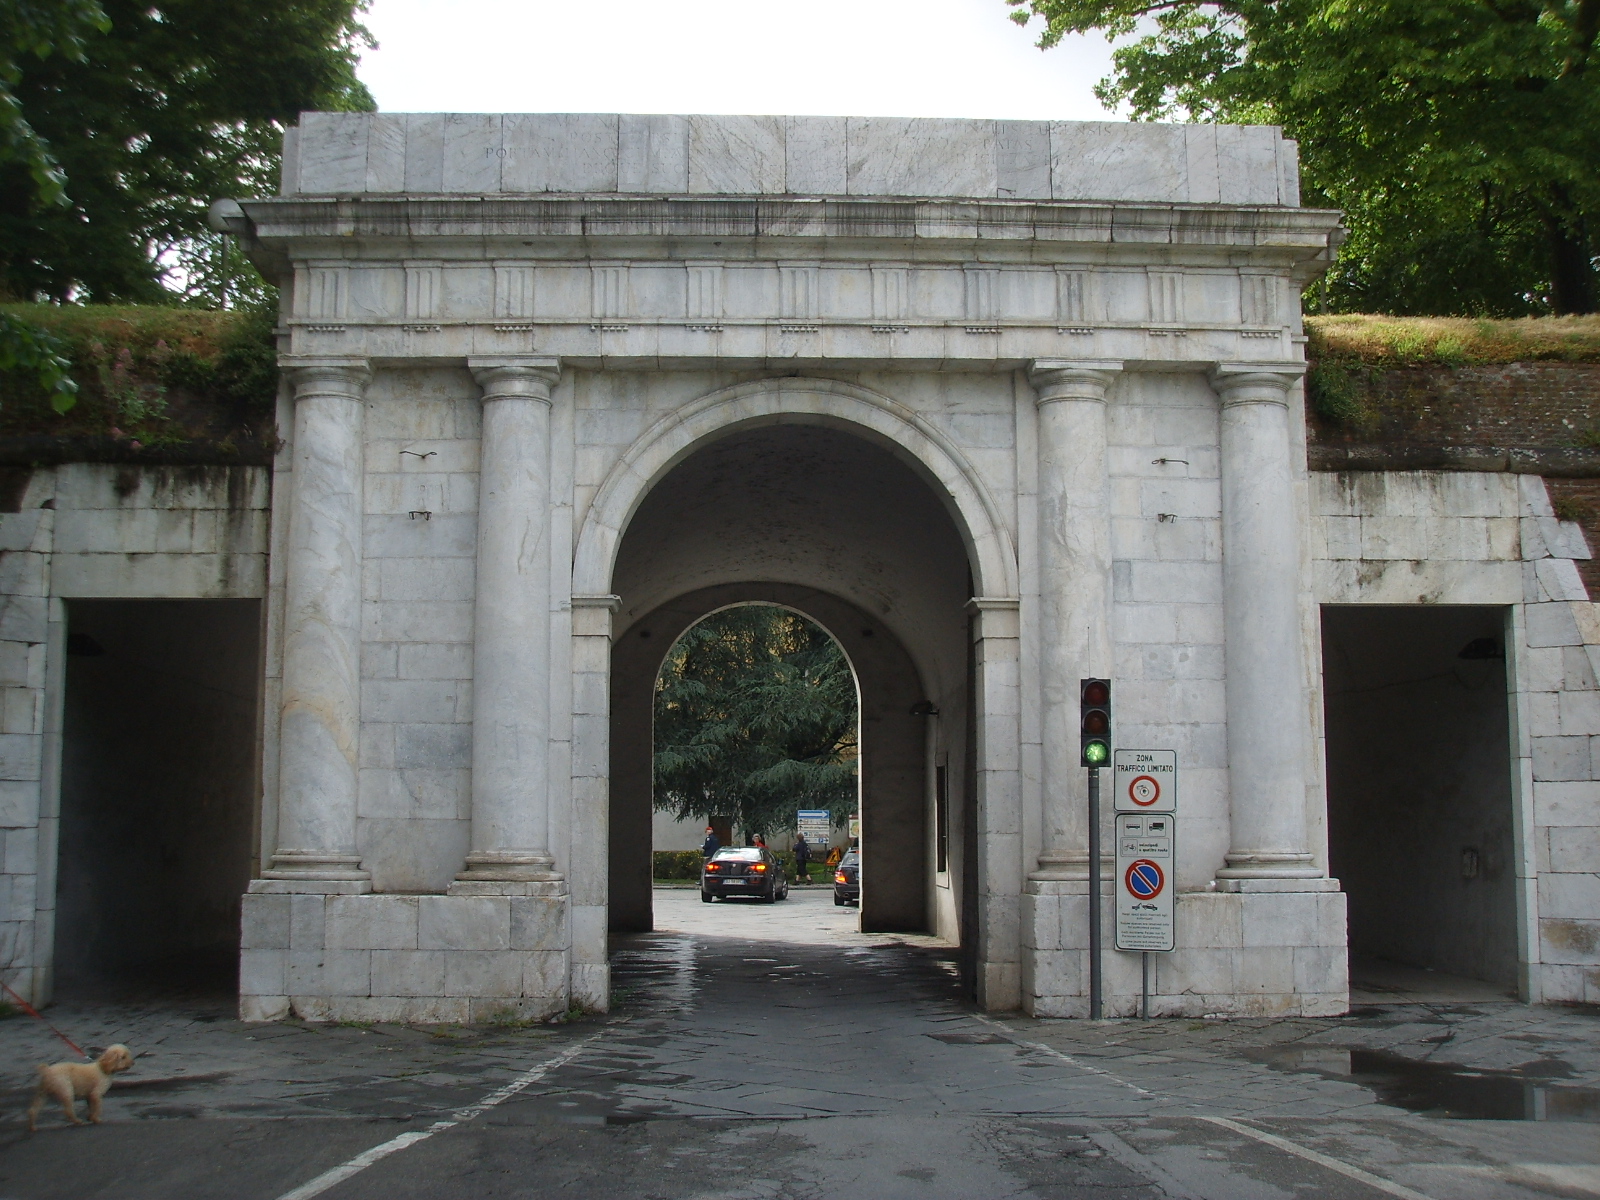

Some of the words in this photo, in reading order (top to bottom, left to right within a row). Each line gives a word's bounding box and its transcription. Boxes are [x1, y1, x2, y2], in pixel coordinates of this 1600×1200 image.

[1135, 754, 1153, 762] ZONA
[1117, 764, 1146, 773] TRAFFICO
[1147, 764, 1173, 773] LIMITATO
